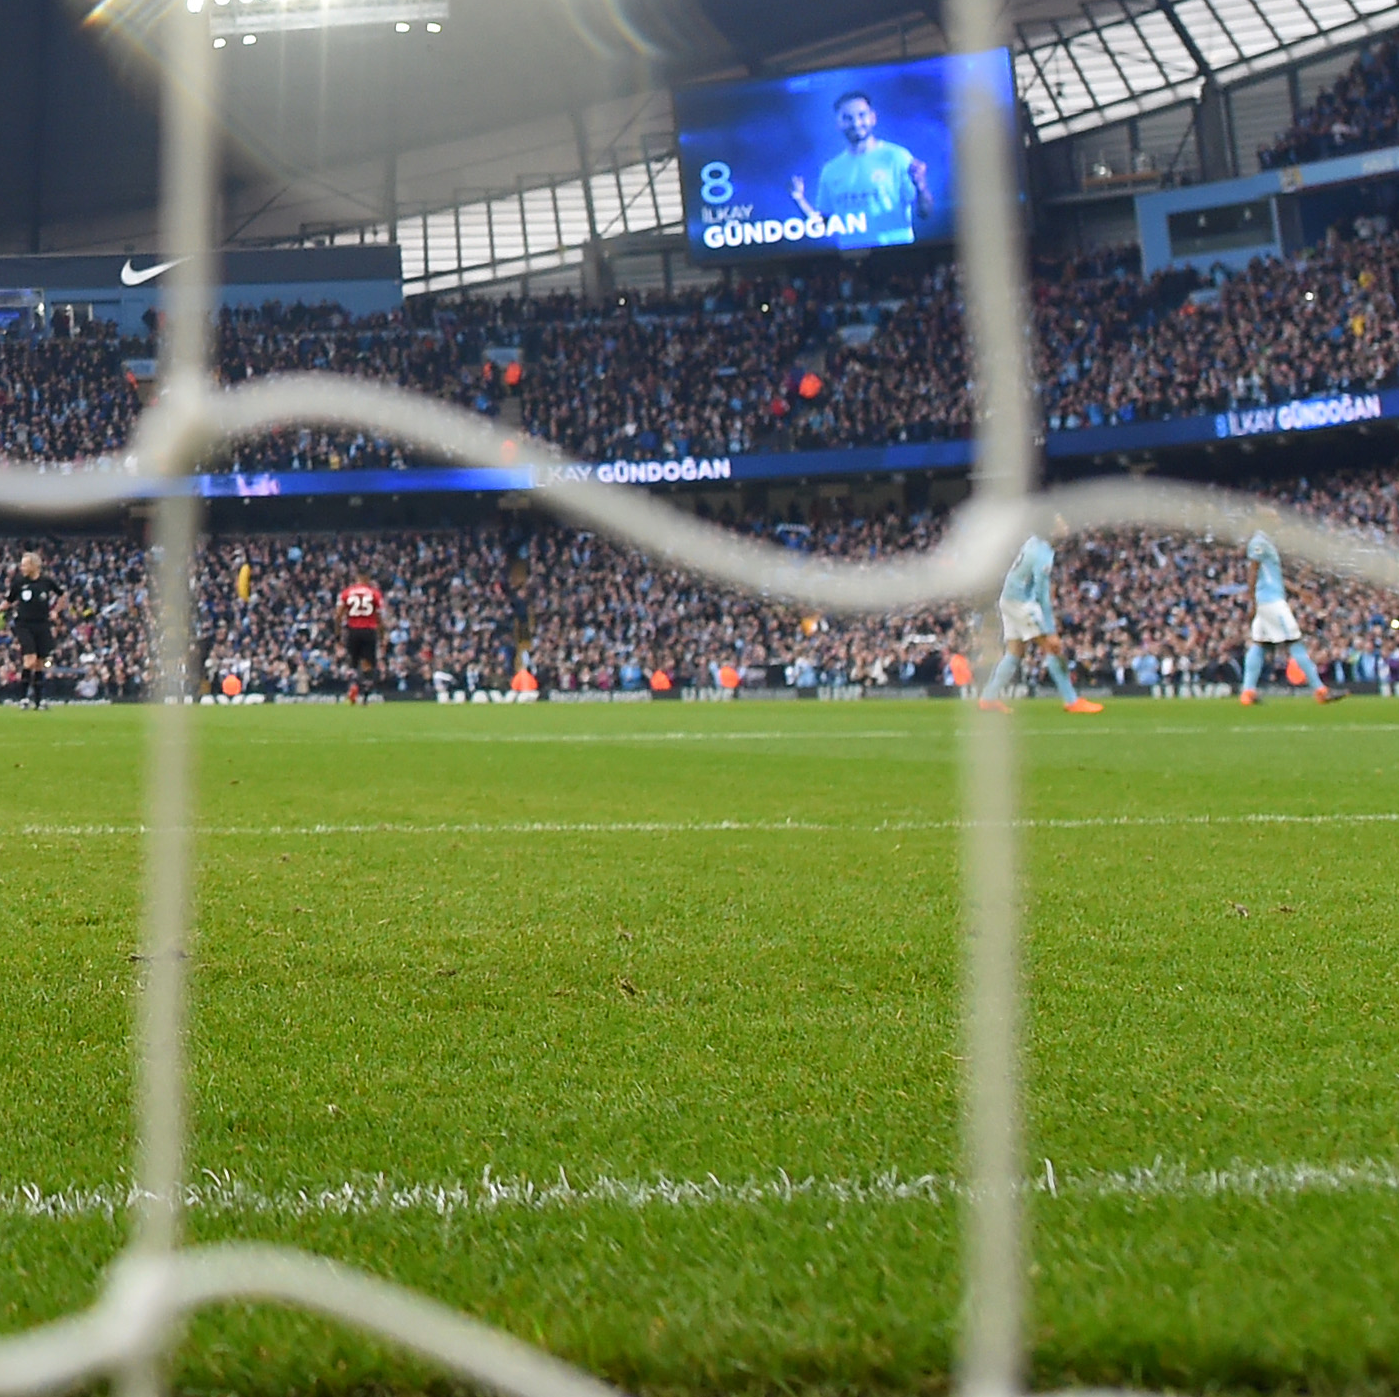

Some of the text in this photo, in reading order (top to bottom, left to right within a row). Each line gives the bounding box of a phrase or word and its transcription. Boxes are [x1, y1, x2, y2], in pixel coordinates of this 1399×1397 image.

[700, 161, 734, 204] 8
[596, 455, 731, 483] GÜNDOĞAN
[347, 594, 374, 617] 25
